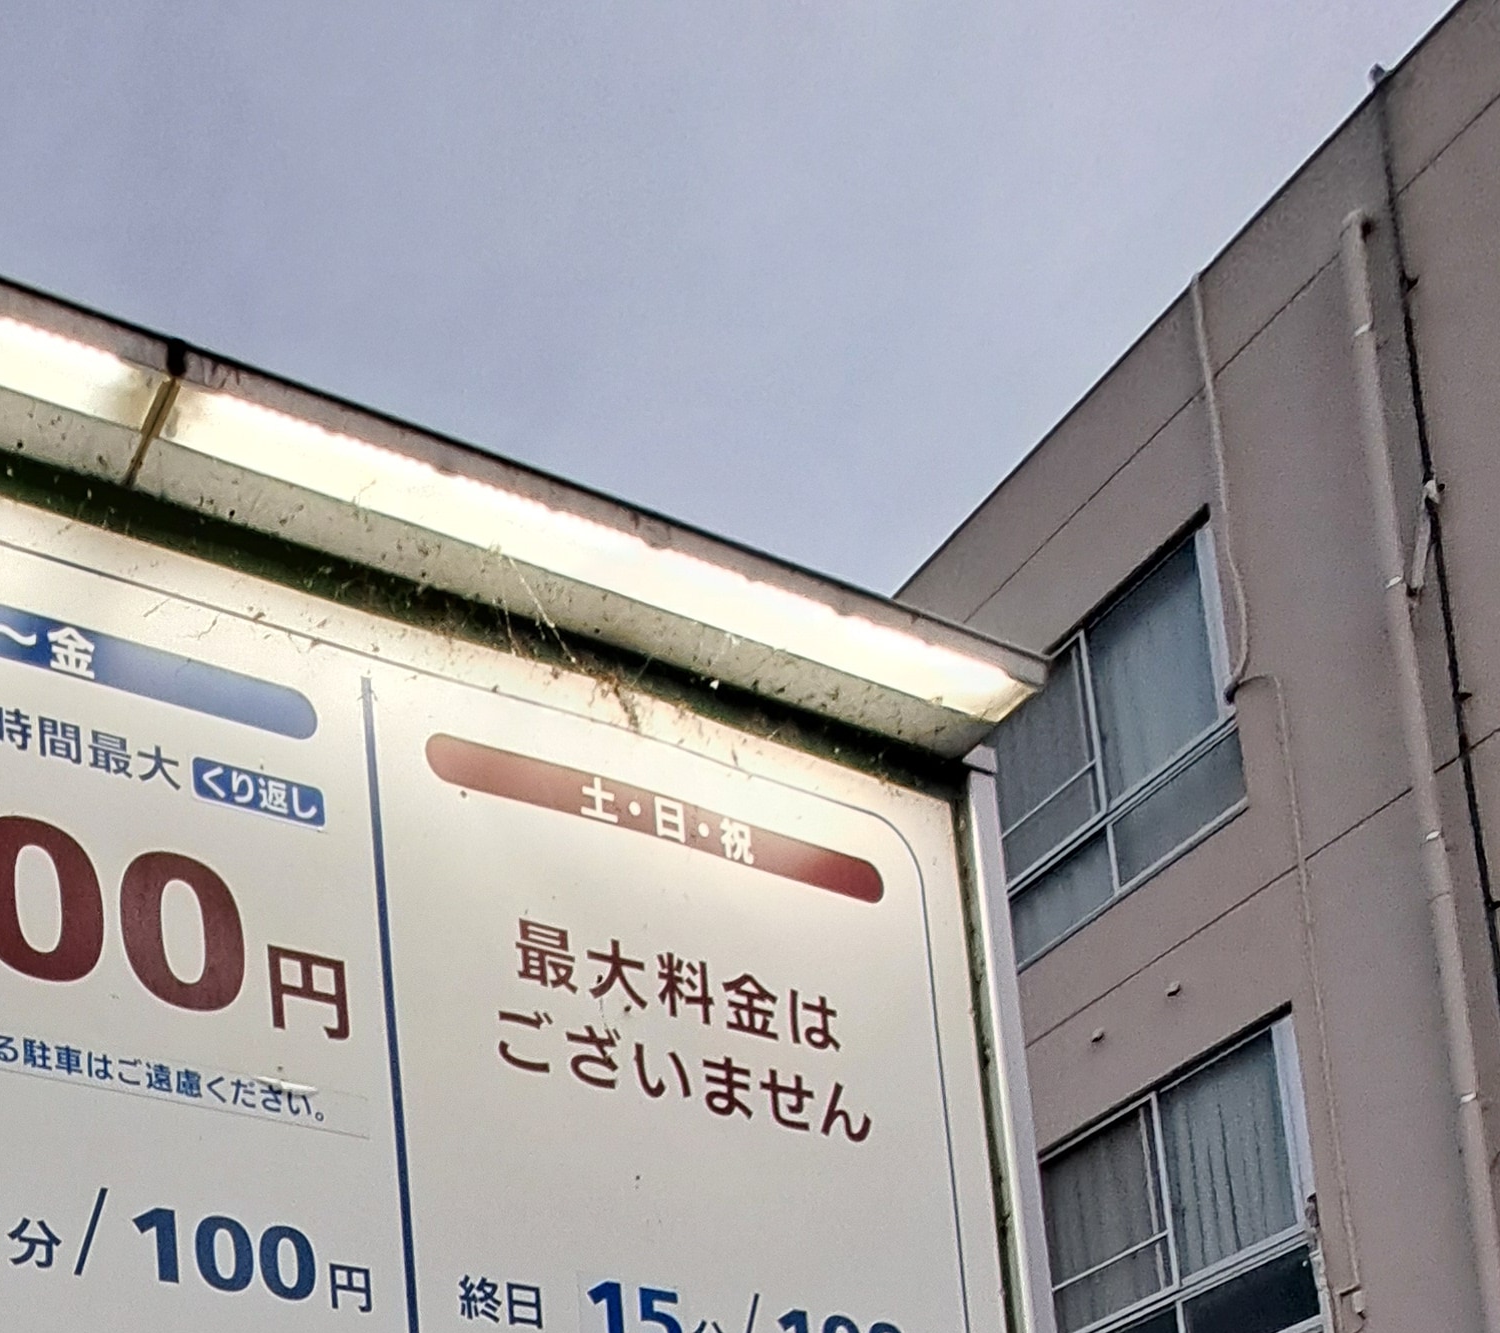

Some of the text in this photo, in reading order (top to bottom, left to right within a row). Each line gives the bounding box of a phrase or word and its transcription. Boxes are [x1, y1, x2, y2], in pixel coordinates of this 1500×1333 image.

[201, 766, 320, 822] くり返し
[515, 918, 841, 1052] 最大料金は
[498, 1010, 872, 1143] ございません
[458, 1274, 543, 1330] 終日
